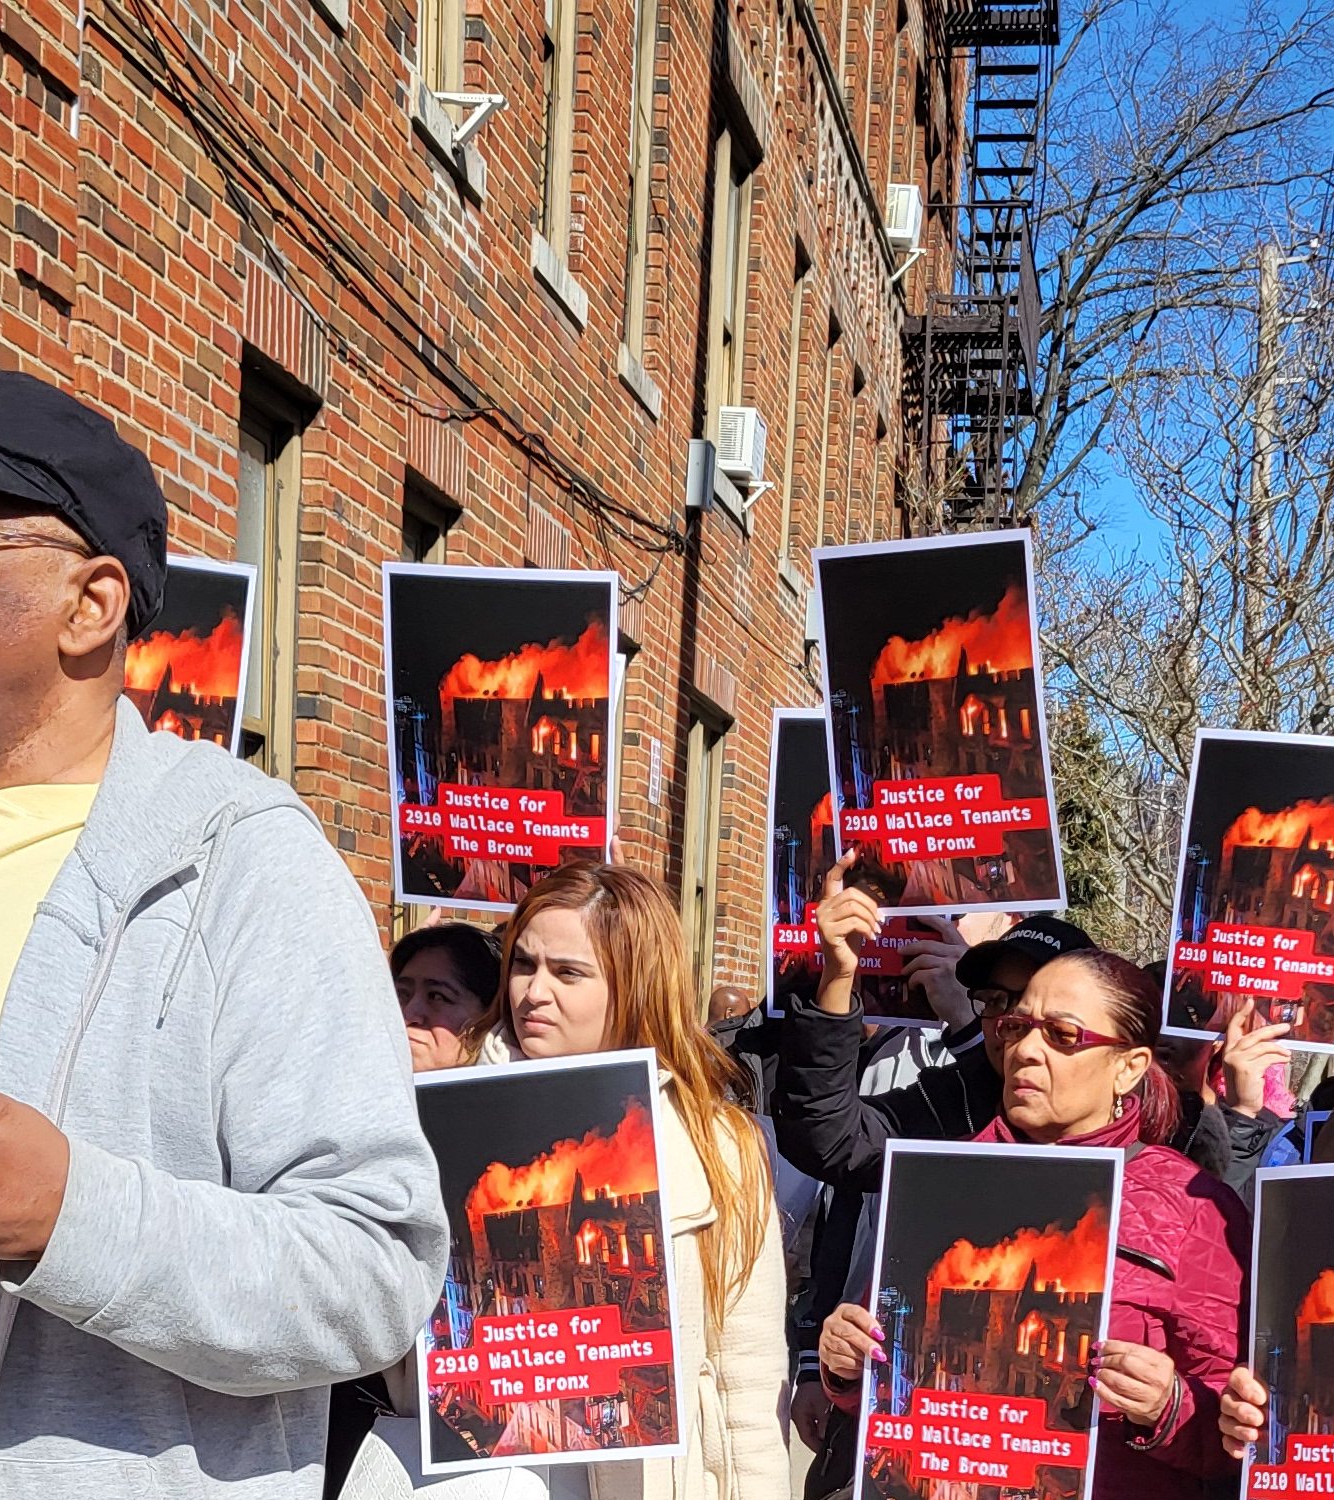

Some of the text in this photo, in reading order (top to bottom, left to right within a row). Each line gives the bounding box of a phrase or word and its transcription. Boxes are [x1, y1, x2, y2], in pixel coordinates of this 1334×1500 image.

[445, 791, 547, 812] Justice for
[880, 784, 983, 805] Justice for
[405, 810, 589, 838] 2910 Wallace Tenants
[845, 806, 1031, 831] 2910 Wallace Tenants
[451, 836, 533, 858] The Bronx
[889, 837, 975, 854] The Bronx
[778, 929, 808, 944] 2910
[1212, 929, 1299, 950] Justice for
[1179, 947, 1334, 976] 2910 Wallace Tenants
[1211, 971, 1279, 992] The Bronx
[483, 1316, 601, 1343] Justice for
[435, 1340, 653, 1374] 2910 Wallace Tenants
[490, 1373, 589, 1397] The Bronx
[920, 1398, 1029, 1424] Justice for
[874, 1421, 1071, 1456] 2910 Wallace Tenants
[920, 1453, 1009, 1478] The Bronx
[1253, 1472, 1287, 1490] 2910
